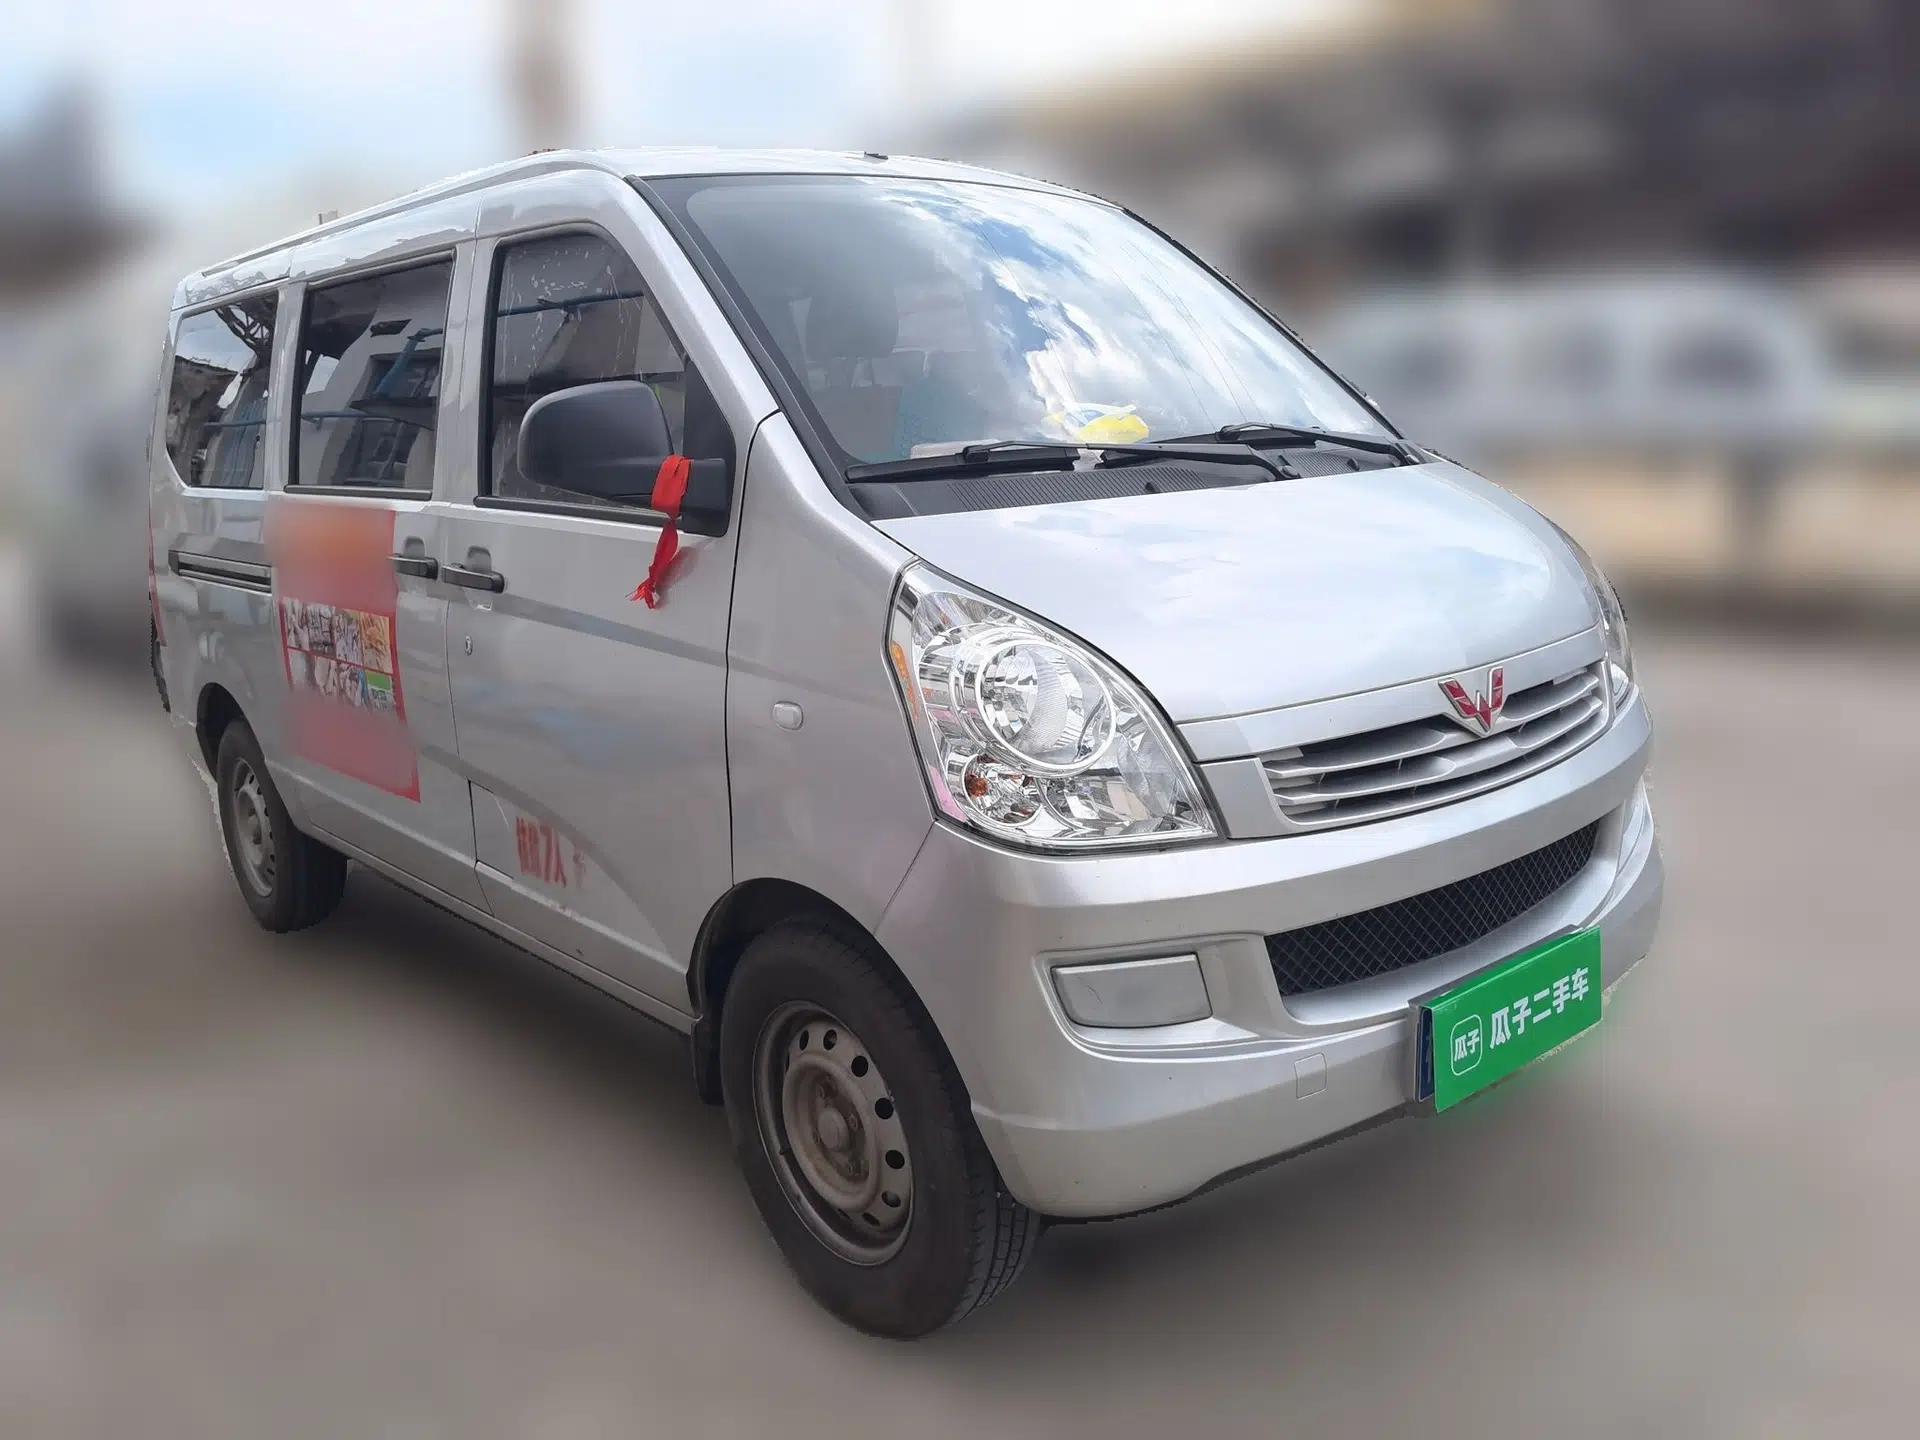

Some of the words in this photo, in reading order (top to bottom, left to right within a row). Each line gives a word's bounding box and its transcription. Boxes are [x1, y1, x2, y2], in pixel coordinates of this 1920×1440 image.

[1490, 967, 1589, 1049] 瓜子二手车
[1454, 1028, 1480, 1062] 瓜子
